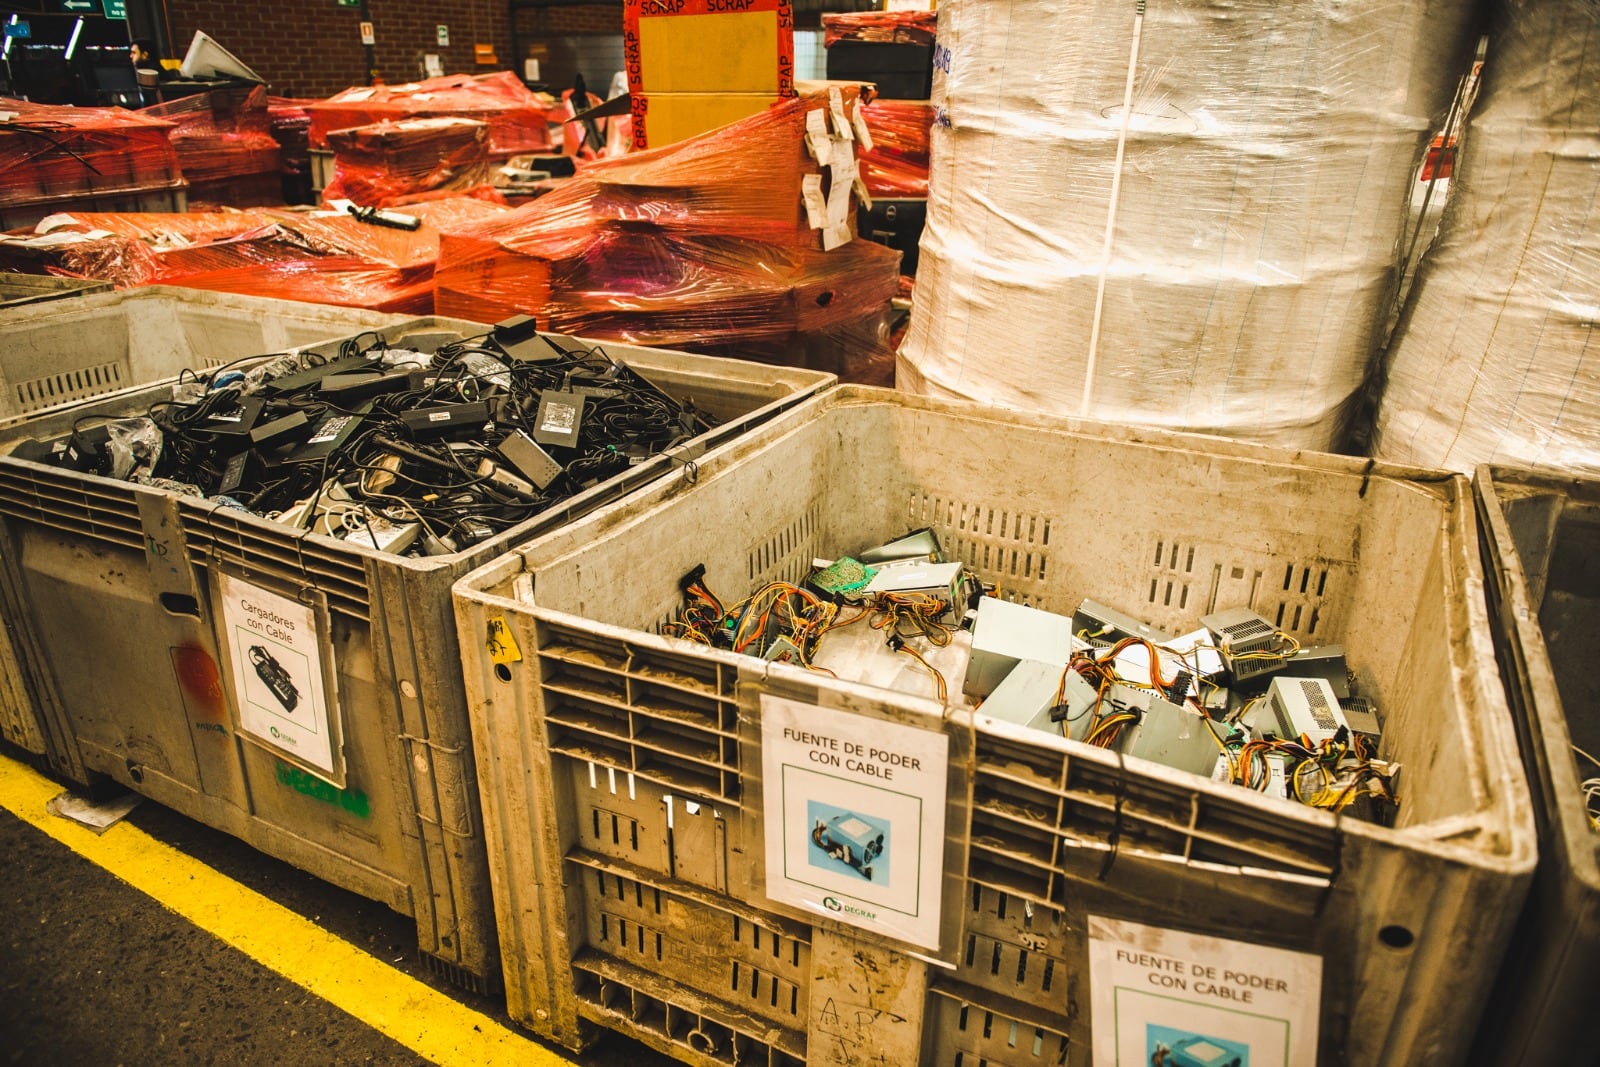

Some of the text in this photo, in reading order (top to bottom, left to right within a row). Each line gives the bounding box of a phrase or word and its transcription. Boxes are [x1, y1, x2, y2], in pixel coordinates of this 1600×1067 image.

[627, 32, 641, 85] SCRAP
[241, 599, 295, 630] Cargadores
[247, 618, 293, 644] con Cable
[783, 727, 921, 771] FUENTE DE PODER
[809, 750, 893, 780] CON CABLE
[1116, 950, 1288, 994] FUENTE DE PODER
[1148, 973, 1253, 1004] CON CABLE
